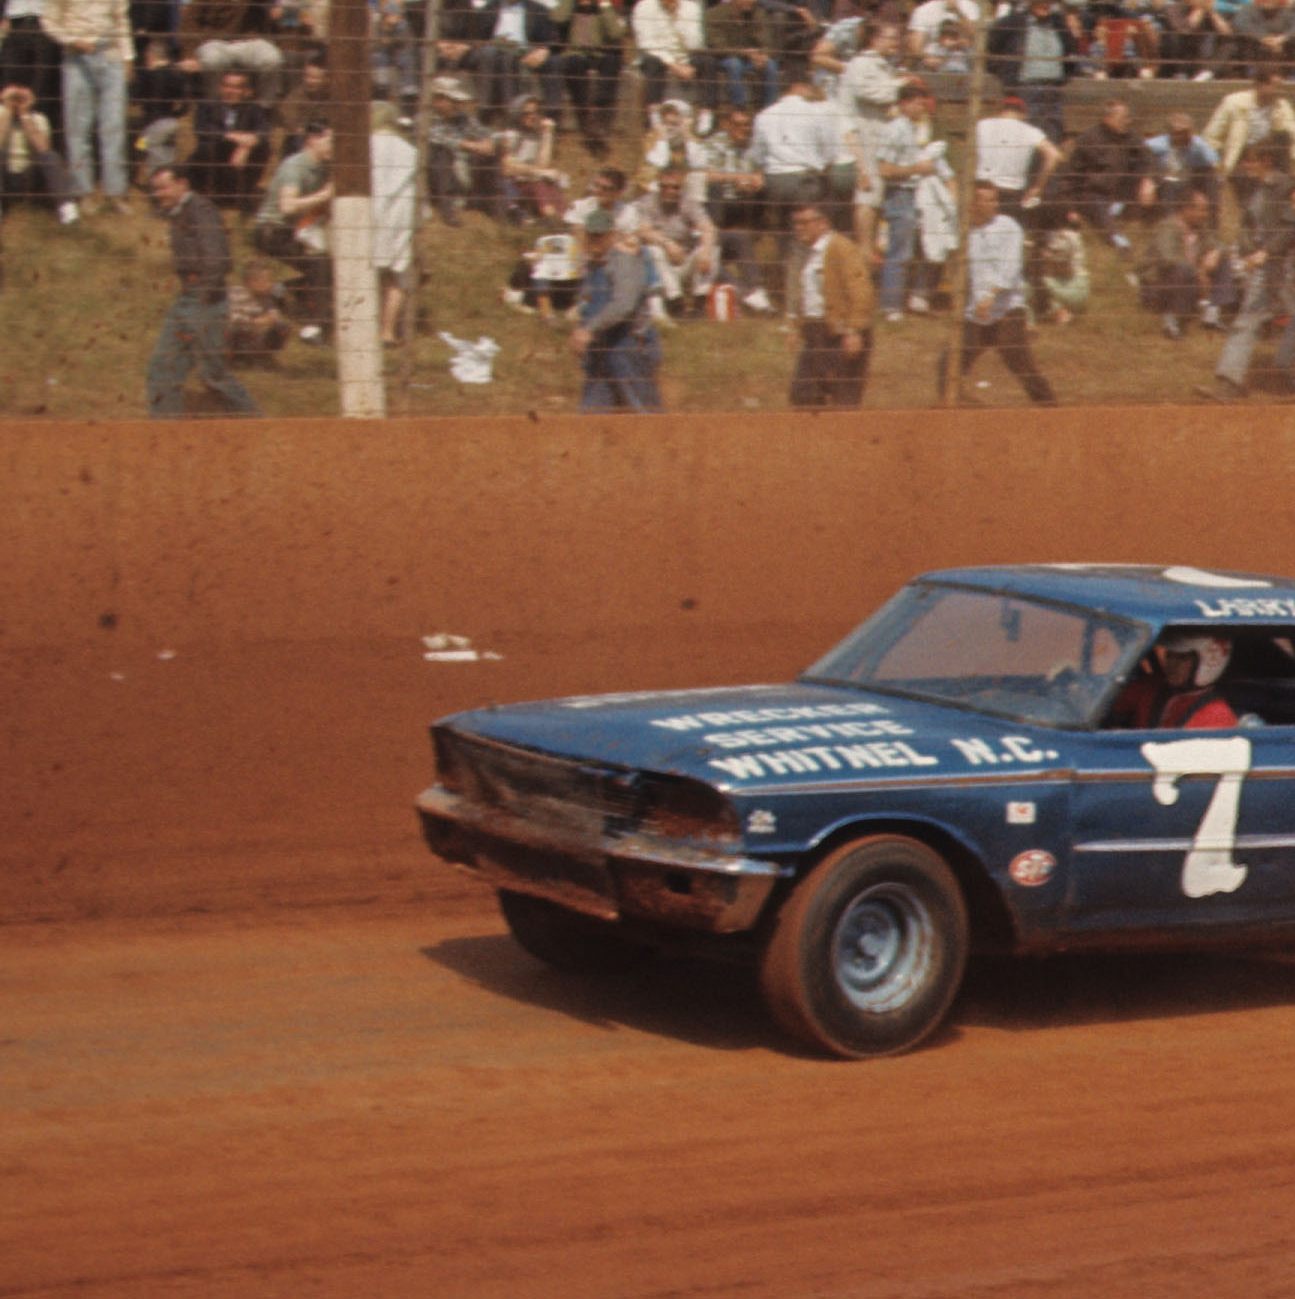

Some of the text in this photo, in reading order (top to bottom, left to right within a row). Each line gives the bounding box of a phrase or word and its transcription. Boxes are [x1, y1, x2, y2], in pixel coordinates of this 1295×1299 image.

[649, 703, 891, 731] WRECKER
[702, 719, 915, 749] SERVICE
[707, 736, 1060, 779] WHITNEL N.C.
[1141, 737, 1251, 898] 7
